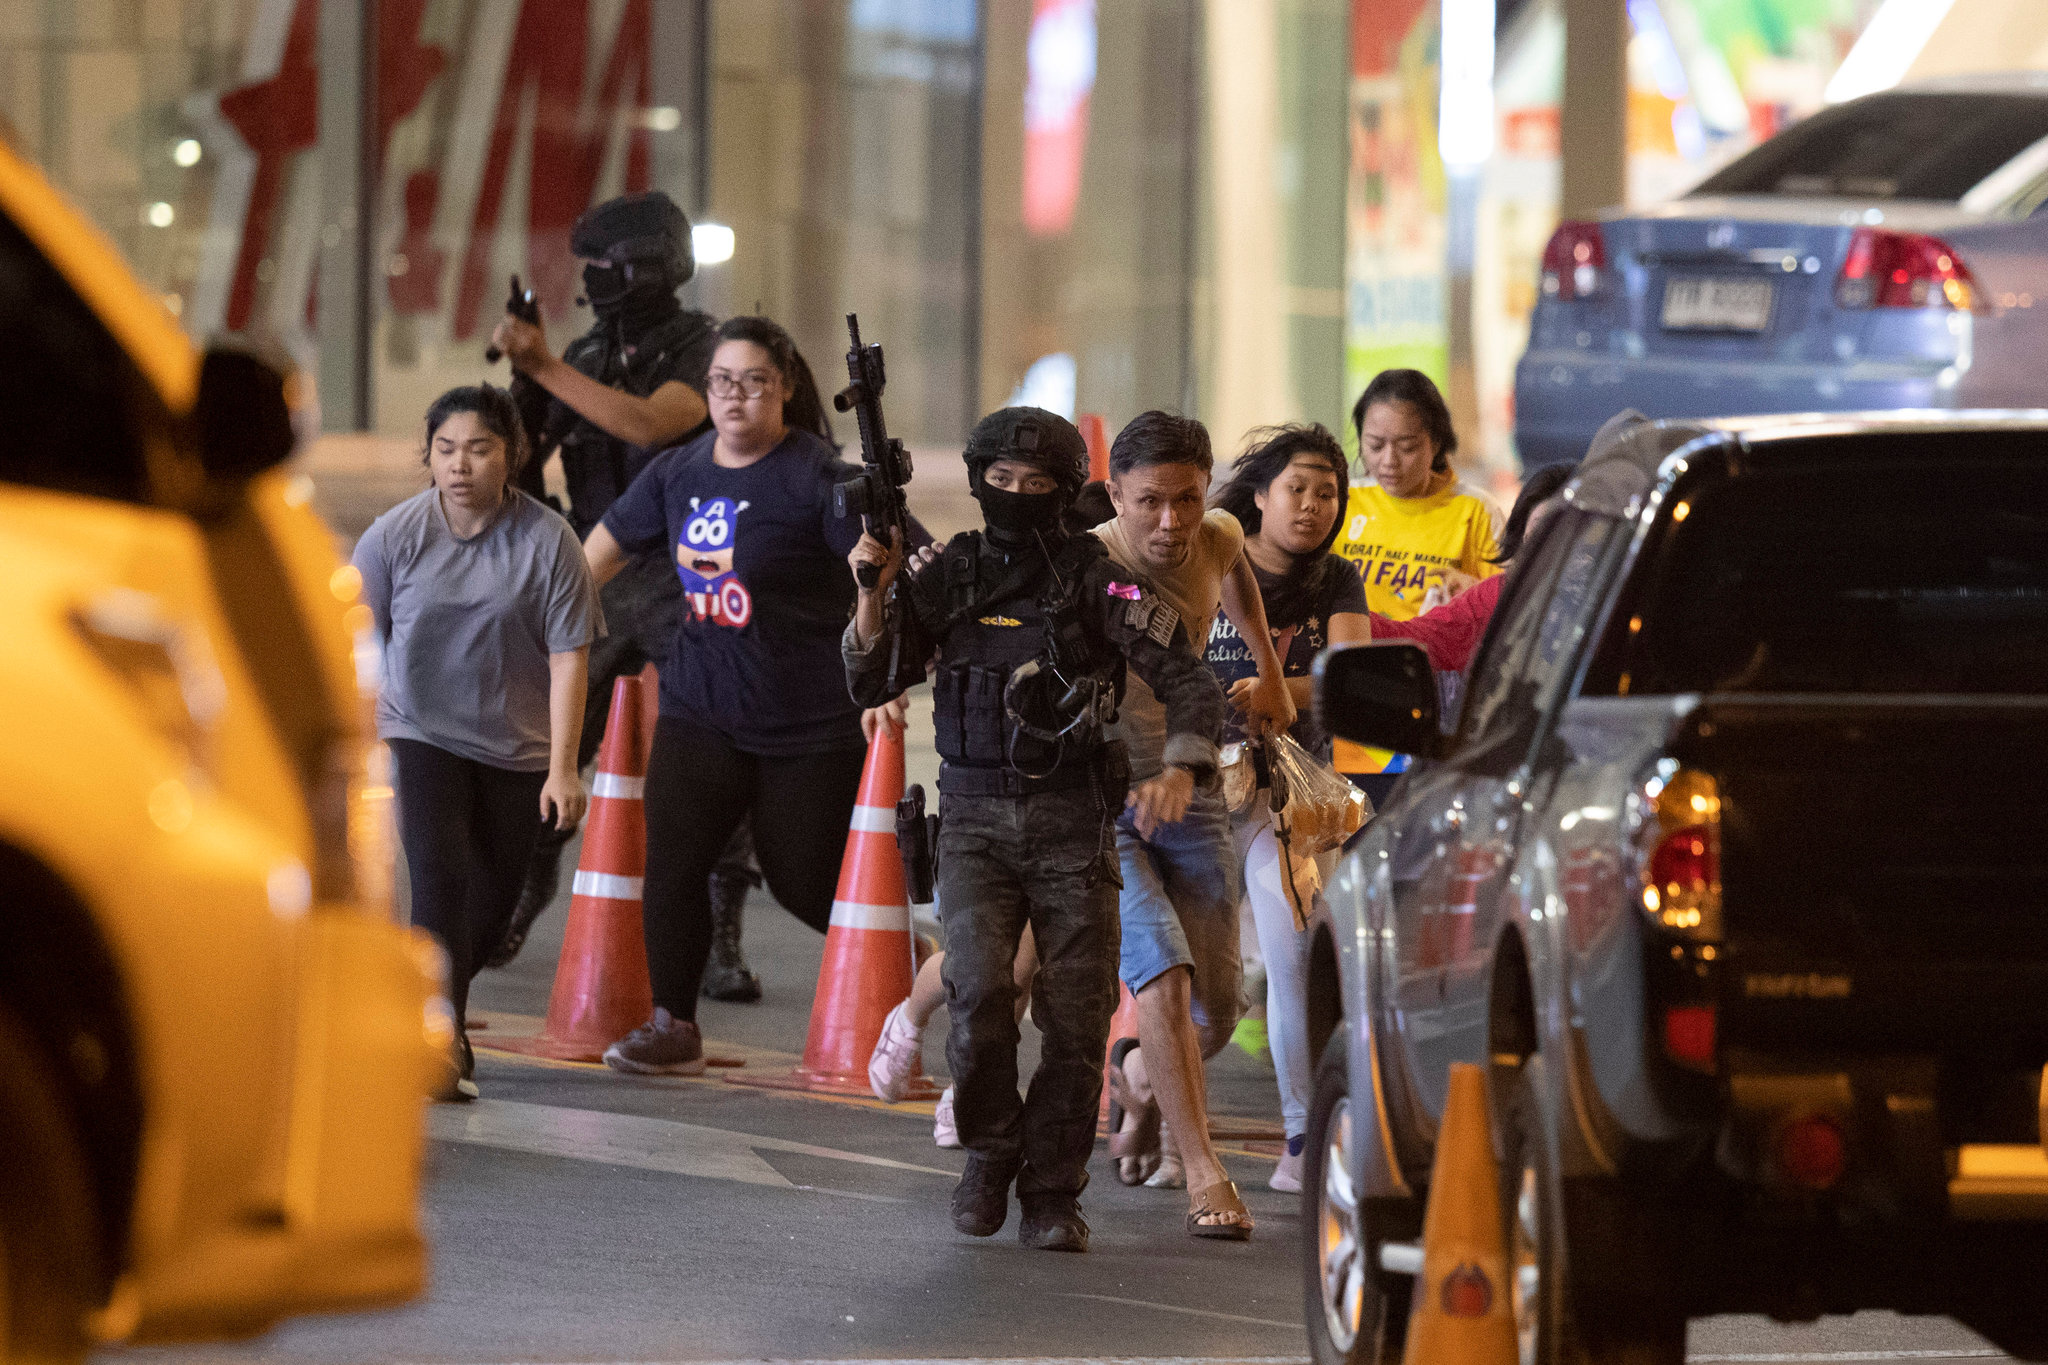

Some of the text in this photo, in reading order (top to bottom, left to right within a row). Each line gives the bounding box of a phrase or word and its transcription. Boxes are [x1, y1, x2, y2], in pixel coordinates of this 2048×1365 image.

[704, 501, 726, 518] A
[1414, 553, 1462, 568] MARAT
[1148, 602, 1169, 640] POLICE
[1208, 645, 1256, 662] alwa
